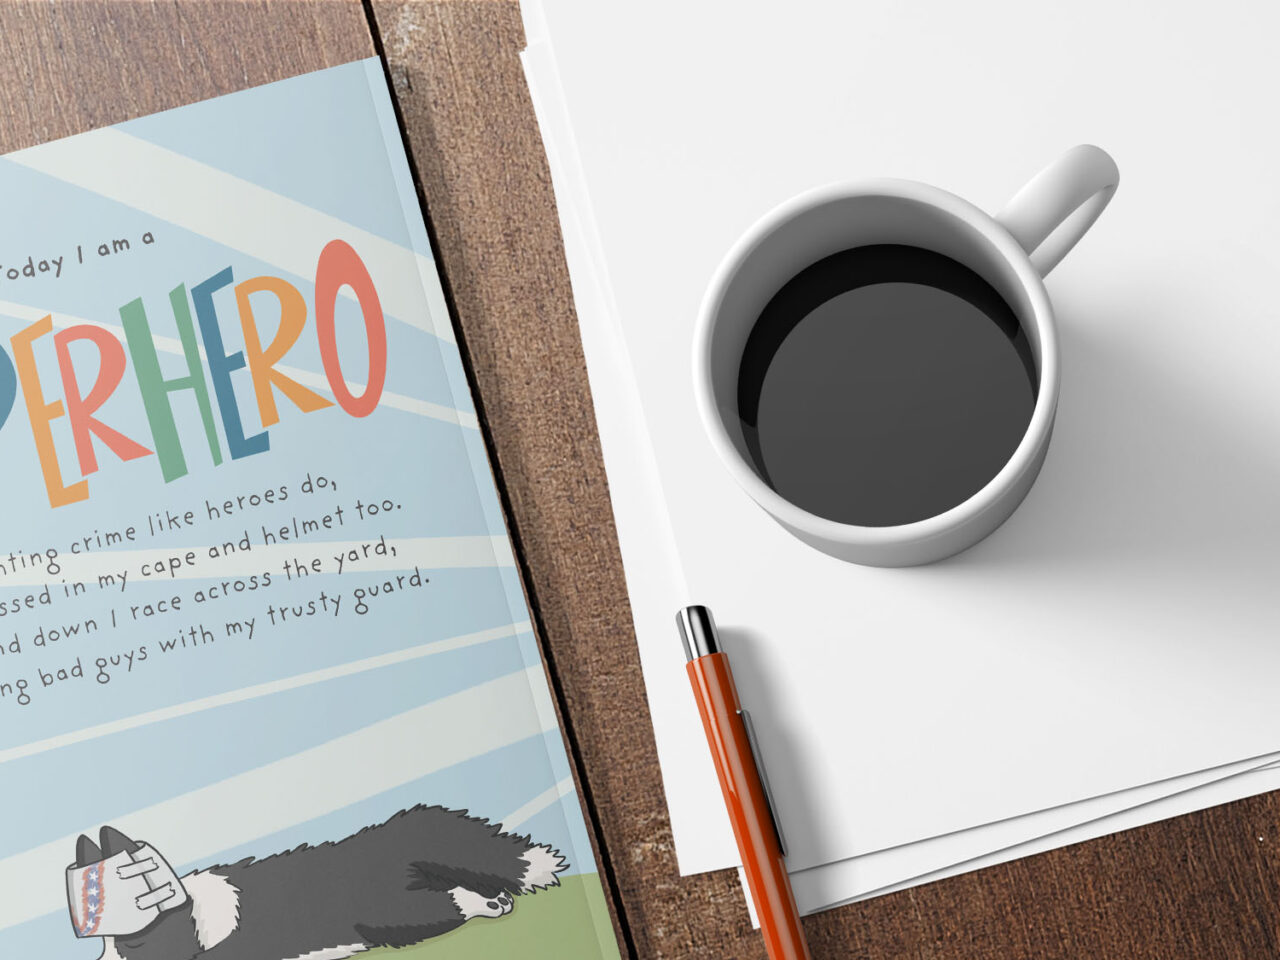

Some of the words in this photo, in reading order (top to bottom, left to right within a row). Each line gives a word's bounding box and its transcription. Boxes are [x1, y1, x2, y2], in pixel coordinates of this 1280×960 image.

[97, 238, 131, 257] am
[141, 231, 155, 245] a
[61, 578, 86, 598] in
[98, 570, 128, 593] my
[141, 551, 196, 579] cape
[208, 530, 252, 559] and
[261, 505, 344, 546] helmet
[355, 499, 402, 521] too.
[70, 526, 136, 555] crime
[148, 510, 194, 537] like
[205, 485, 289, 521] heroes
[300, 472, 337, 494] do,
[33, 619, 98, 647] down
[130, 595, 182, 621] race
[194, 571, 272, 603] across
[282, 558, 322, 581] the
[333, 534, 397, 575] yard,
[37, 657, 84, 688] bad
[95, 646, 148, 685] guys
[158, 624, 215, 653] with
[225, 617, 255, 640] my
[266, 591, 342, 626] trusty
[353, 566, 430, 616] guard.
